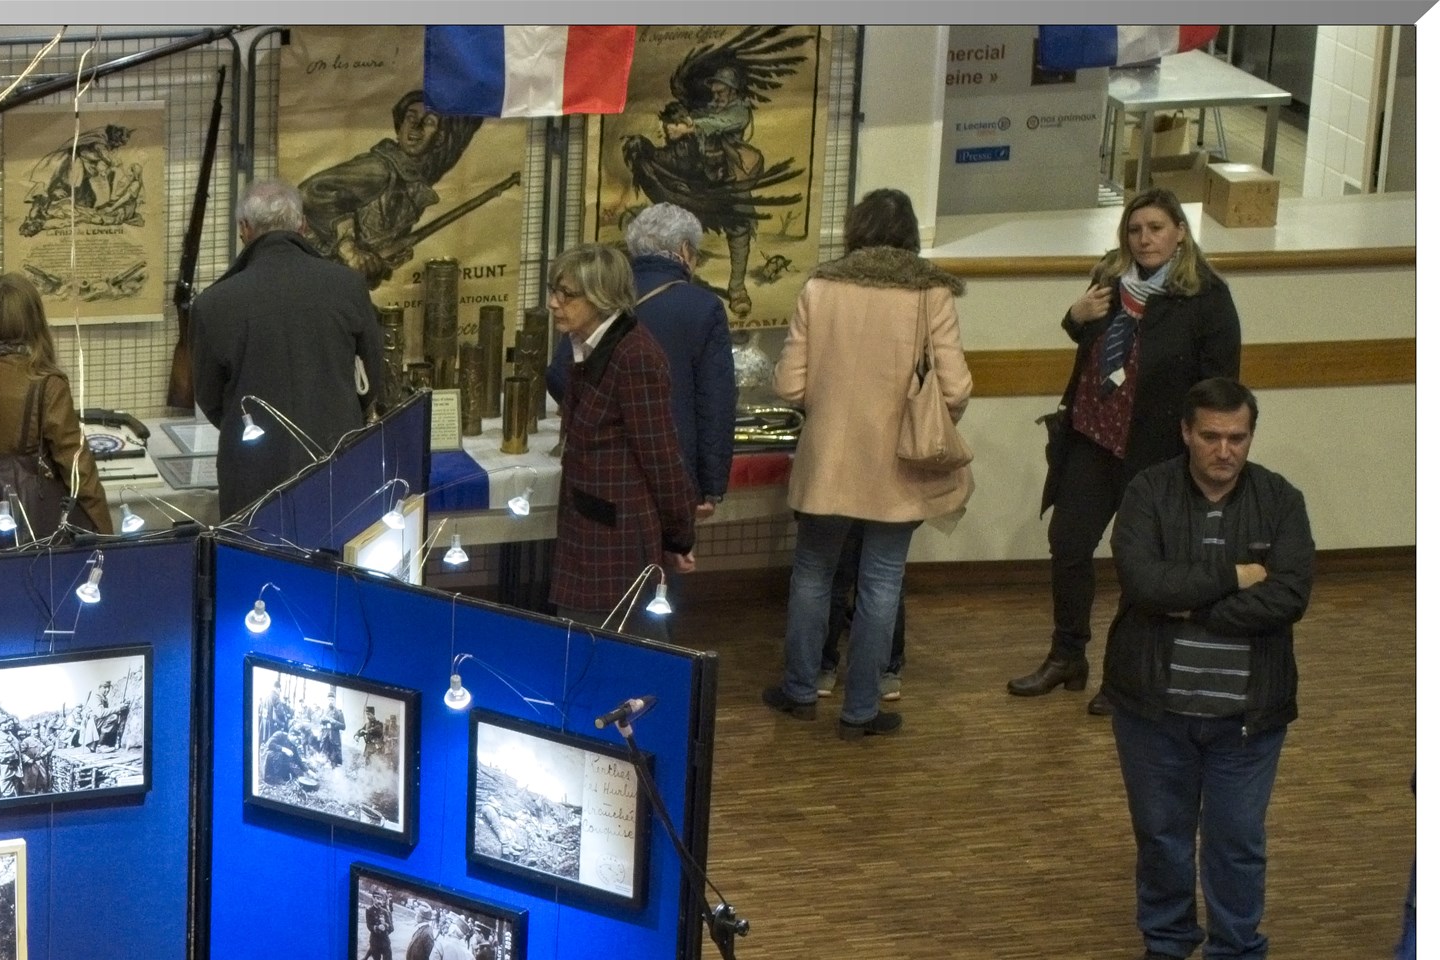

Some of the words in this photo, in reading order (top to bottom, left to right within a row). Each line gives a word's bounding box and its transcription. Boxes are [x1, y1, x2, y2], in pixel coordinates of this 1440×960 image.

[946, 71, 983, 86] eine
[462, 264, 507, 280] RUNT
[460, 294, 509, 304] ATIONALE
